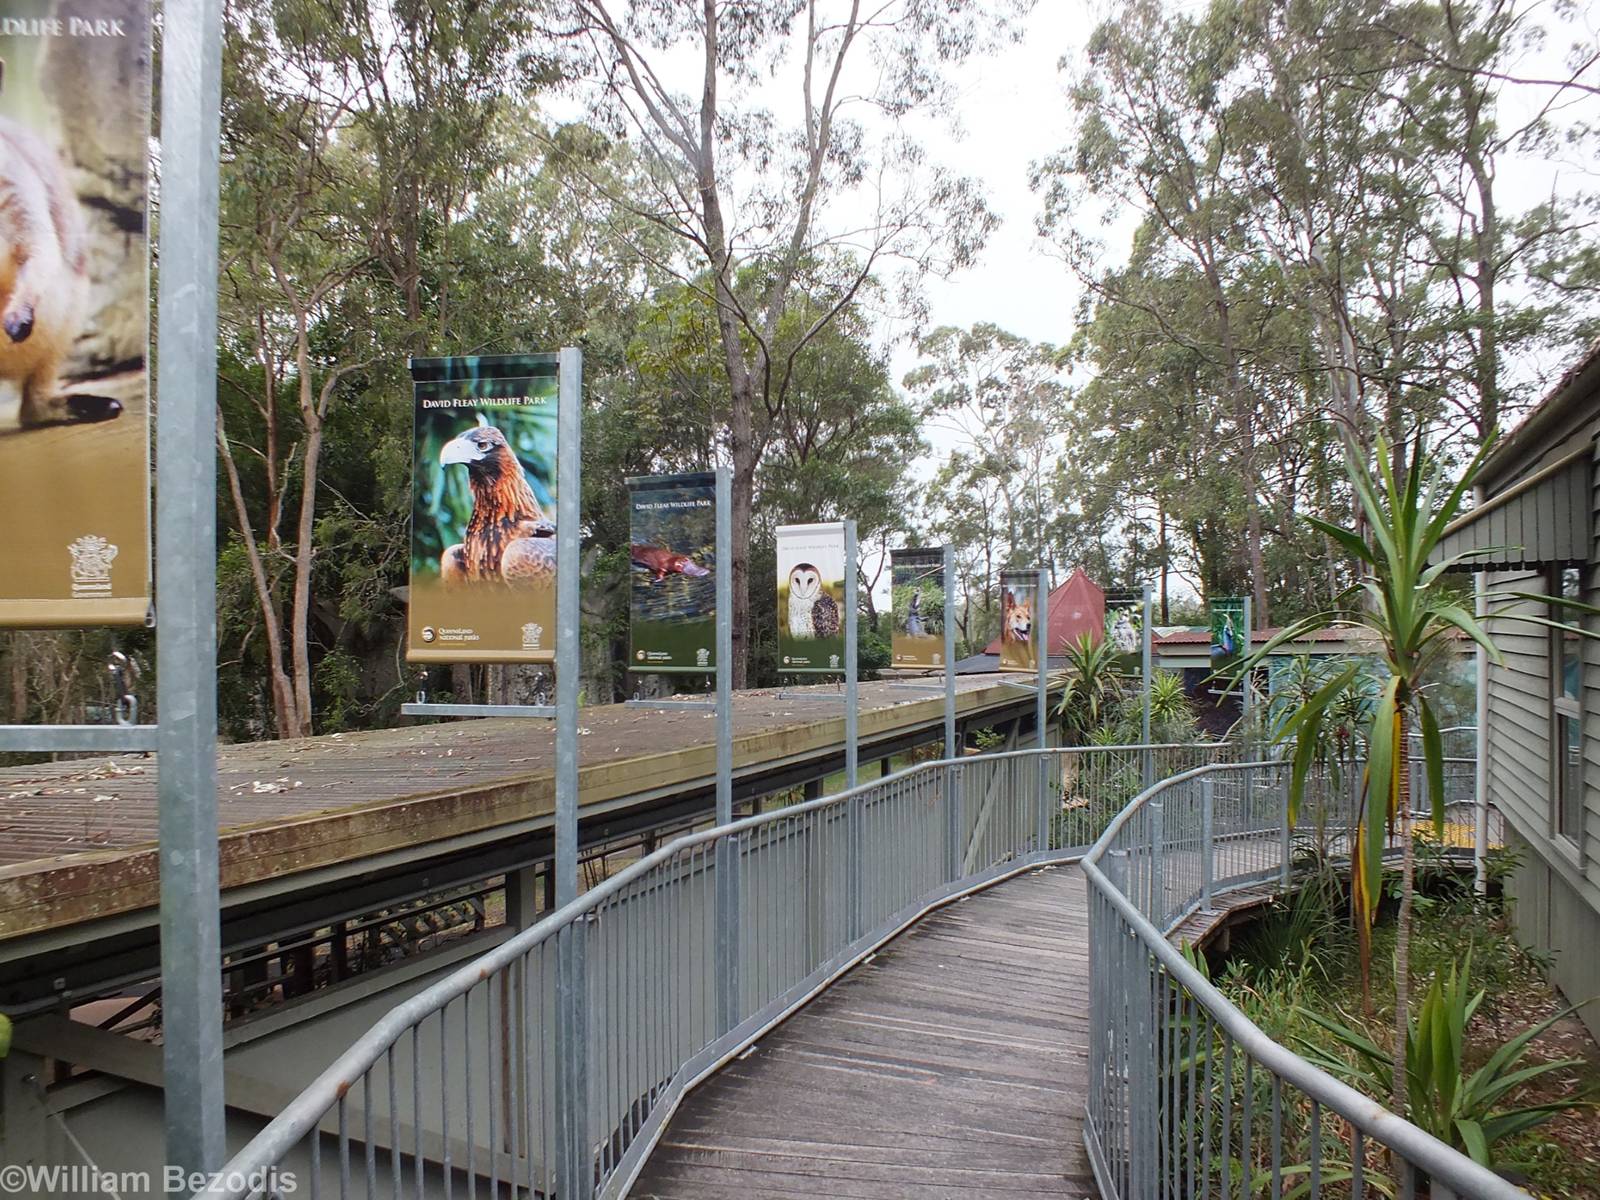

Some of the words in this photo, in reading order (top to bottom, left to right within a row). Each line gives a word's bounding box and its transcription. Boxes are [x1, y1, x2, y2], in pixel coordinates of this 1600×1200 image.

[0, 17, 63, 37] DLIFE
[68, 16, 127, 37] PARK
[423, 399, 451, 409] DAVID
[452, 398, 479, 408] FLEAY
[479, 397, 521, 407] WILDLIFE
[523, 396, 547, 405] PARK
